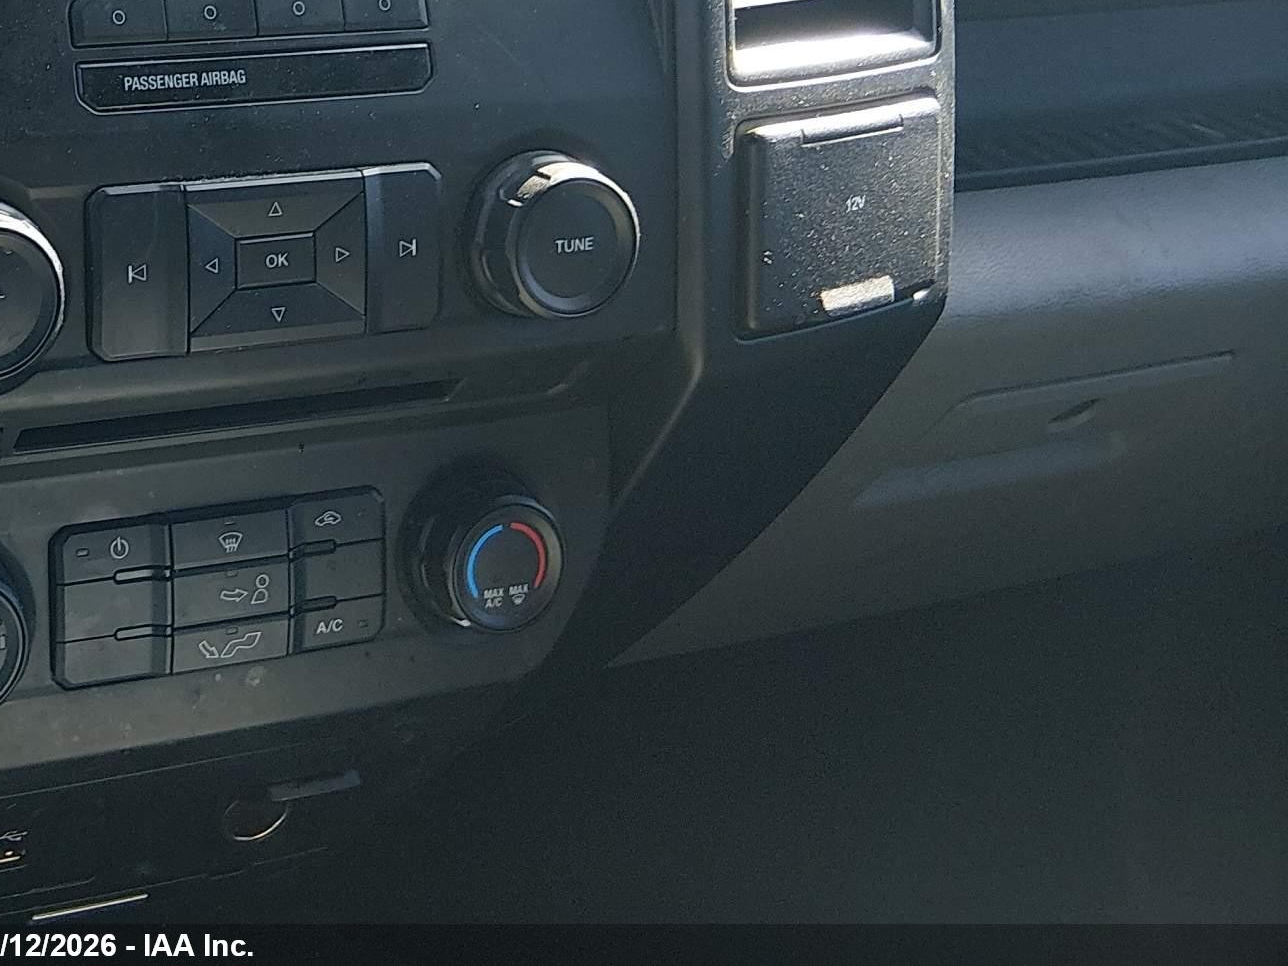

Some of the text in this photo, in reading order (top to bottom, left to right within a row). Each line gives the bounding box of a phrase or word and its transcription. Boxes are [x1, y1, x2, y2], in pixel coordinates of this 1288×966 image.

[124, 69, 247, 91] PASSENGER AIRBAG
[845, 194, 866, 214] 12V
[554, 235, 595, 254] TUNE
[265, 253, 290, 268] OK
[315, 618, 343, 634] A/C
